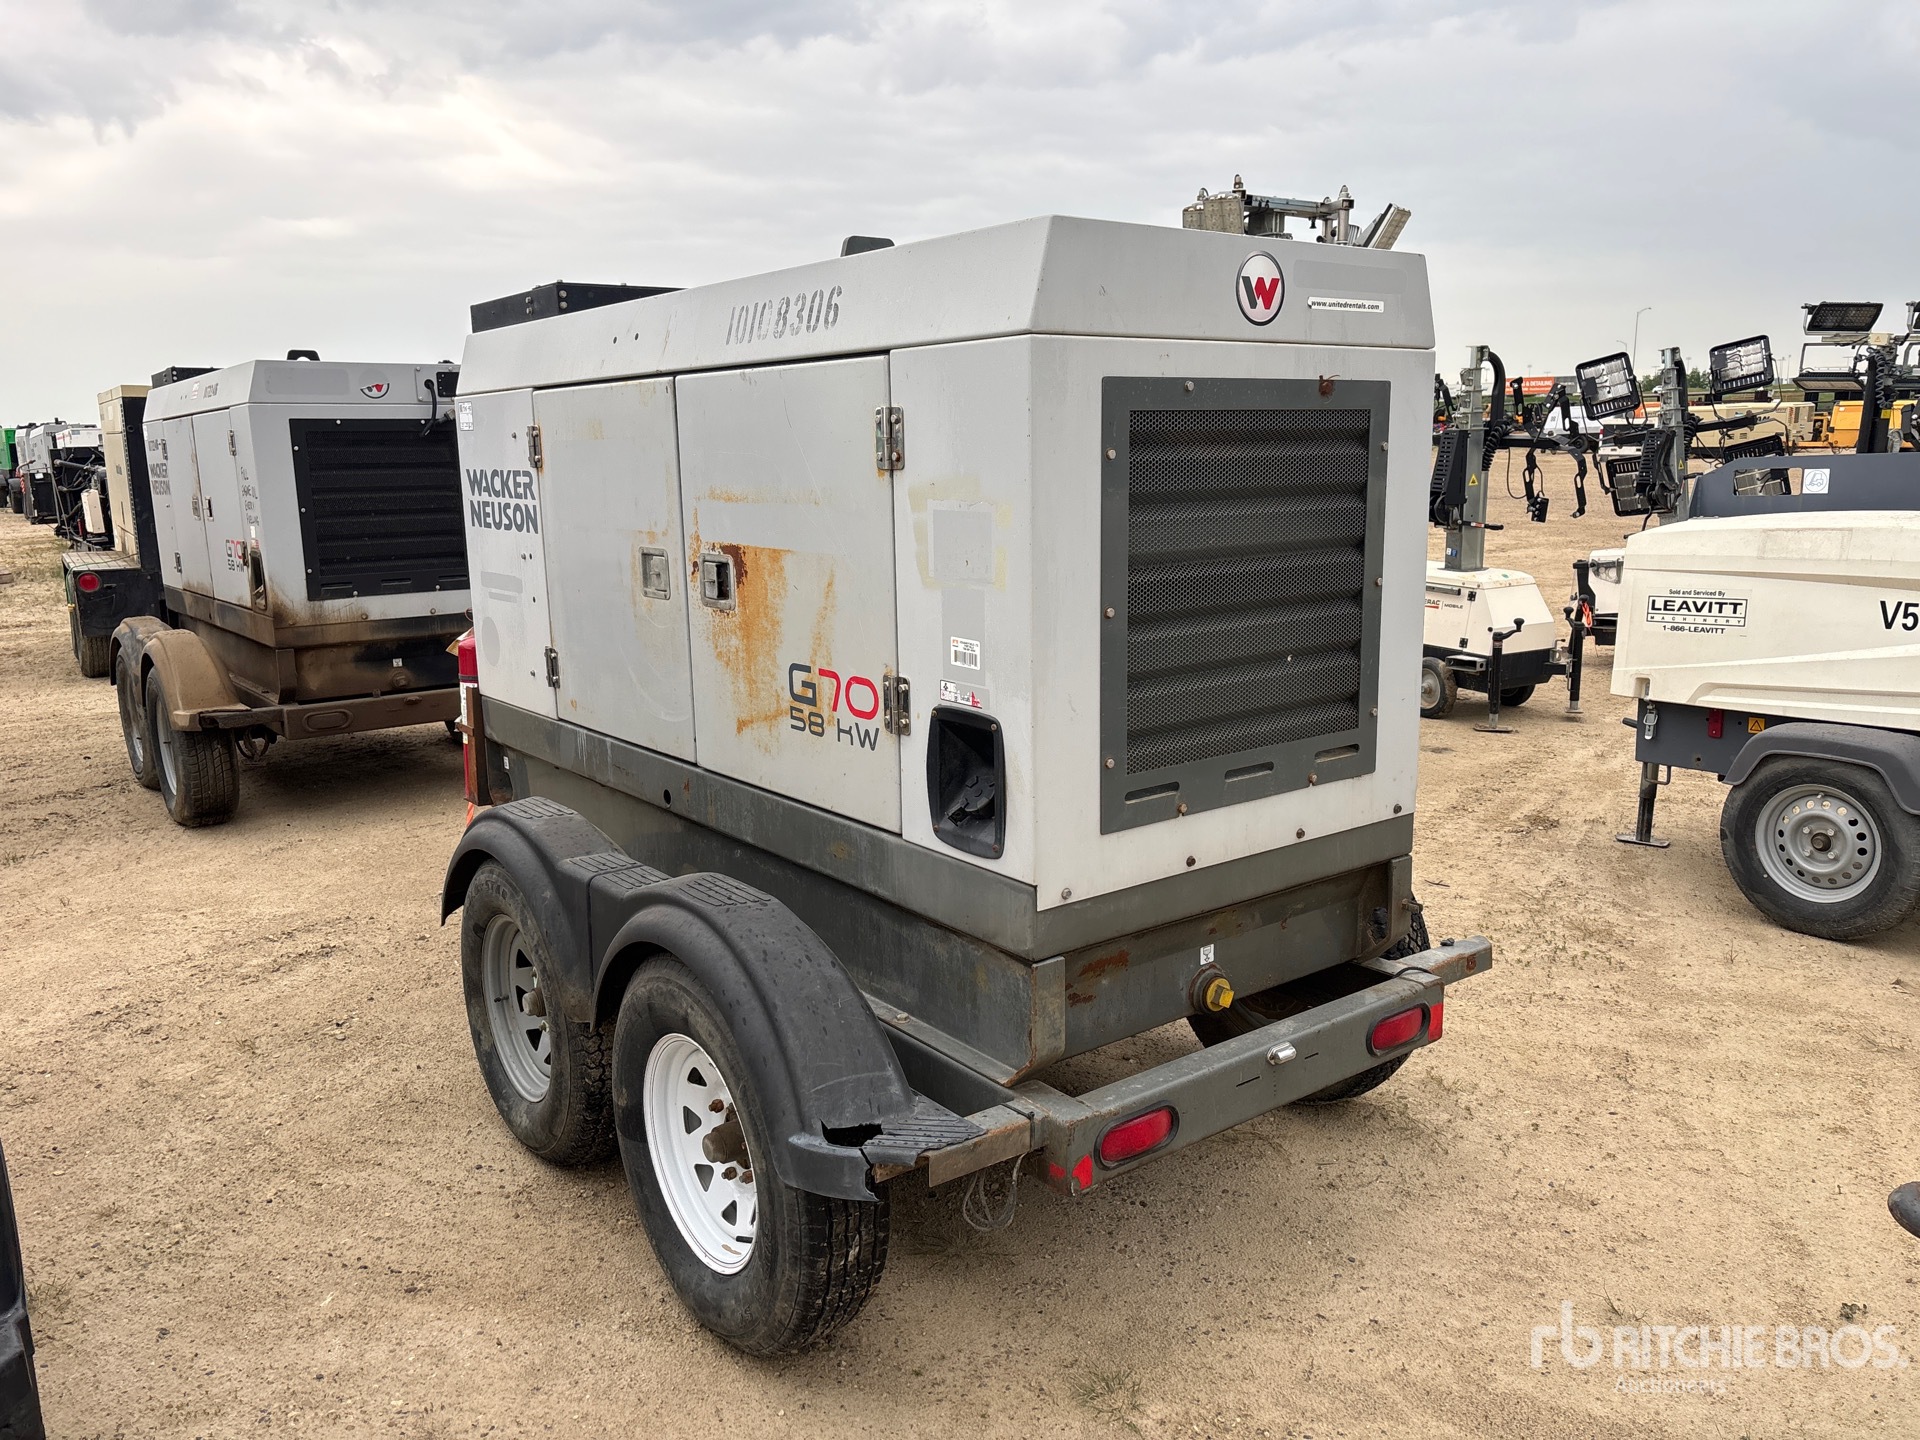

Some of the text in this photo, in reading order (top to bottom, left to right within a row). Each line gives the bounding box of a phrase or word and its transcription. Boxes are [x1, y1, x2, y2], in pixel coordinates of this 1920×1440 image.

[1311, 300, 1380, 311] www.unitedrentals.com
[466, 468, 536, 500] WACKER
[470, 500, 539, 534] NEUSON
[1669, 588, 1681, 596] Sold
[1693, 589, 1717, 597] Serviced
[1718, 590, 1726, 598] By
[1651, 599, 1743, 615] LEAVITT
[1650, 615, 1742, 625] MACHINERY
[1662, 624, 1726, 635] 1-866-LEAVITT
[788, 662, 880, 721] G70
[790, 705, 825, 738] 58
